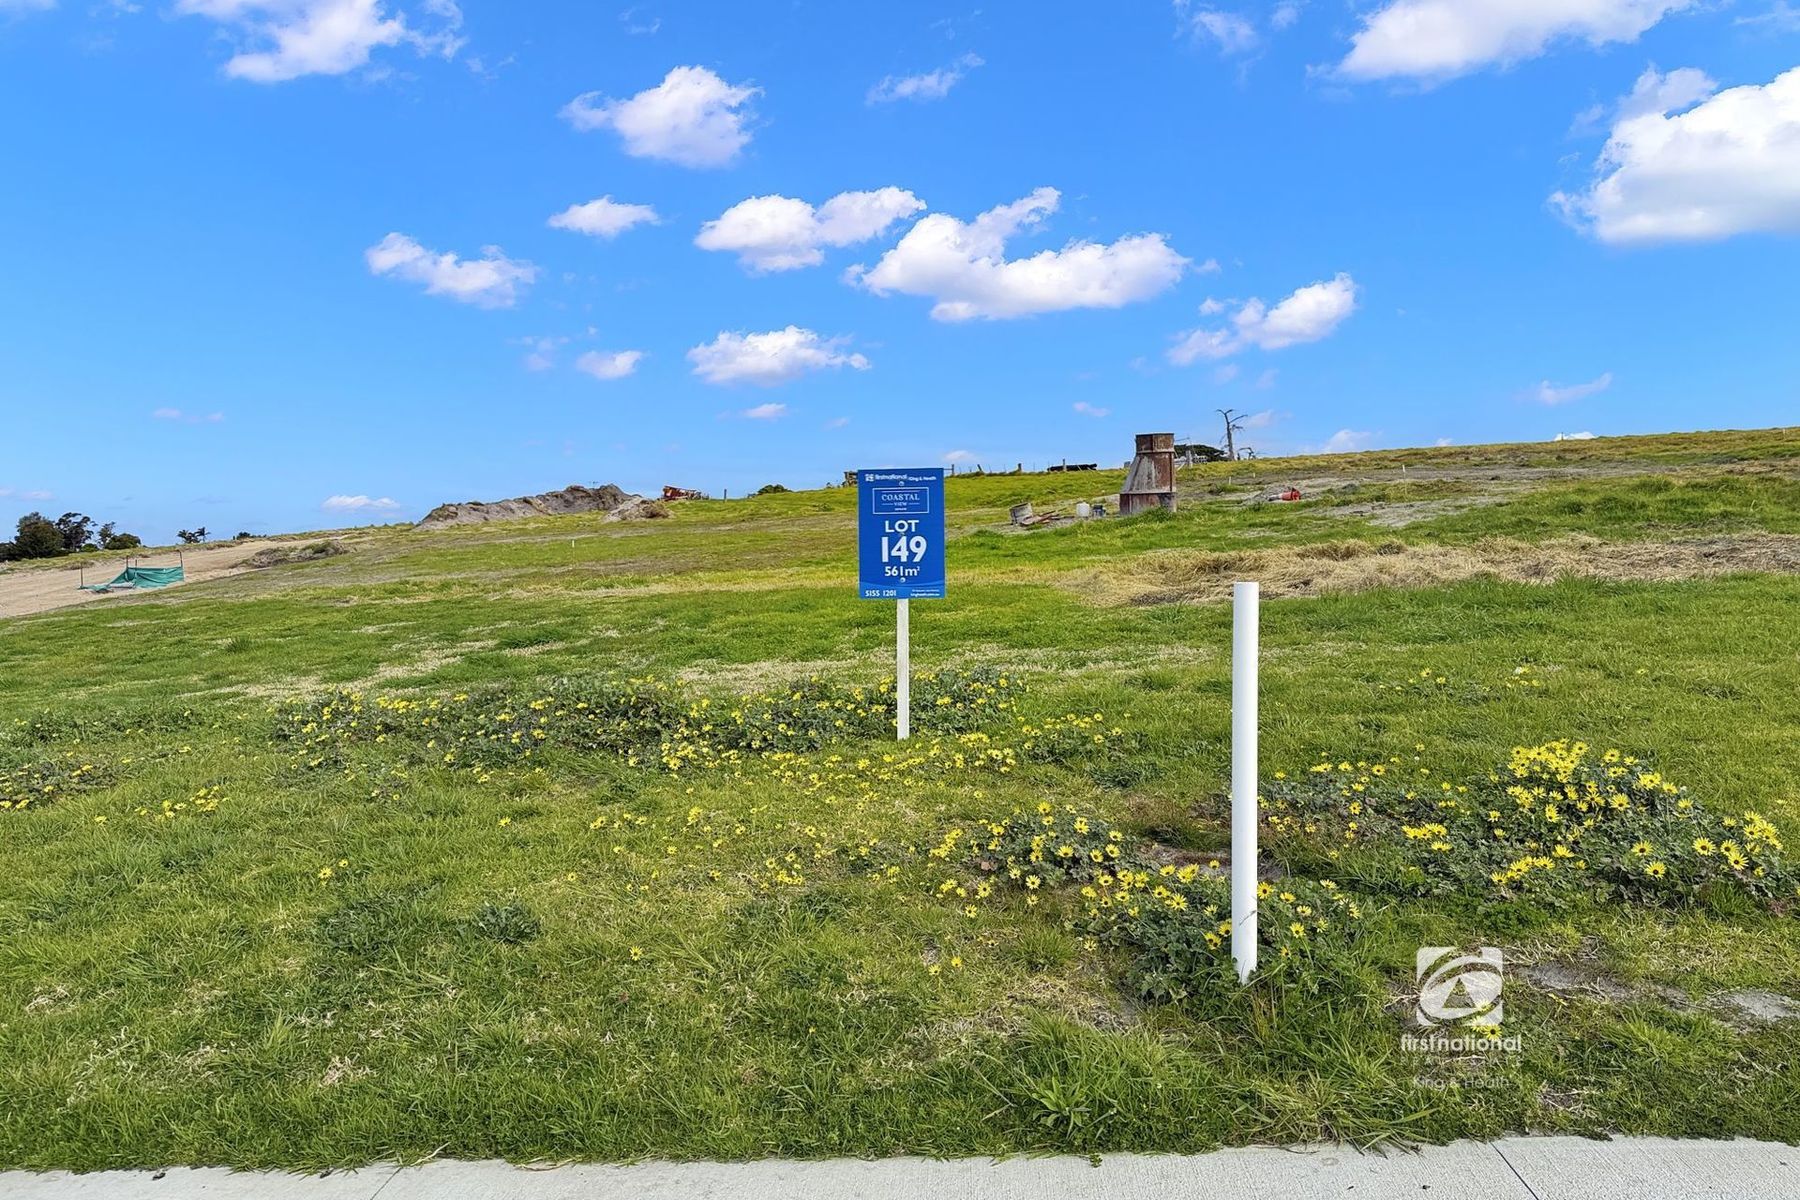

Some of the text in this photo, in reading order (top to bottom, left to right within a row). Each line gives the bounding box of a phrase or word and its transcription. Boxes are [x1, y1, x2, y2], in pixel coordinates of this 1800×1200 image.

[881, 493, 920, 501] COASTAL
[885, 520, 919, 532] LOT
[881, 535, 927, 562] 149
